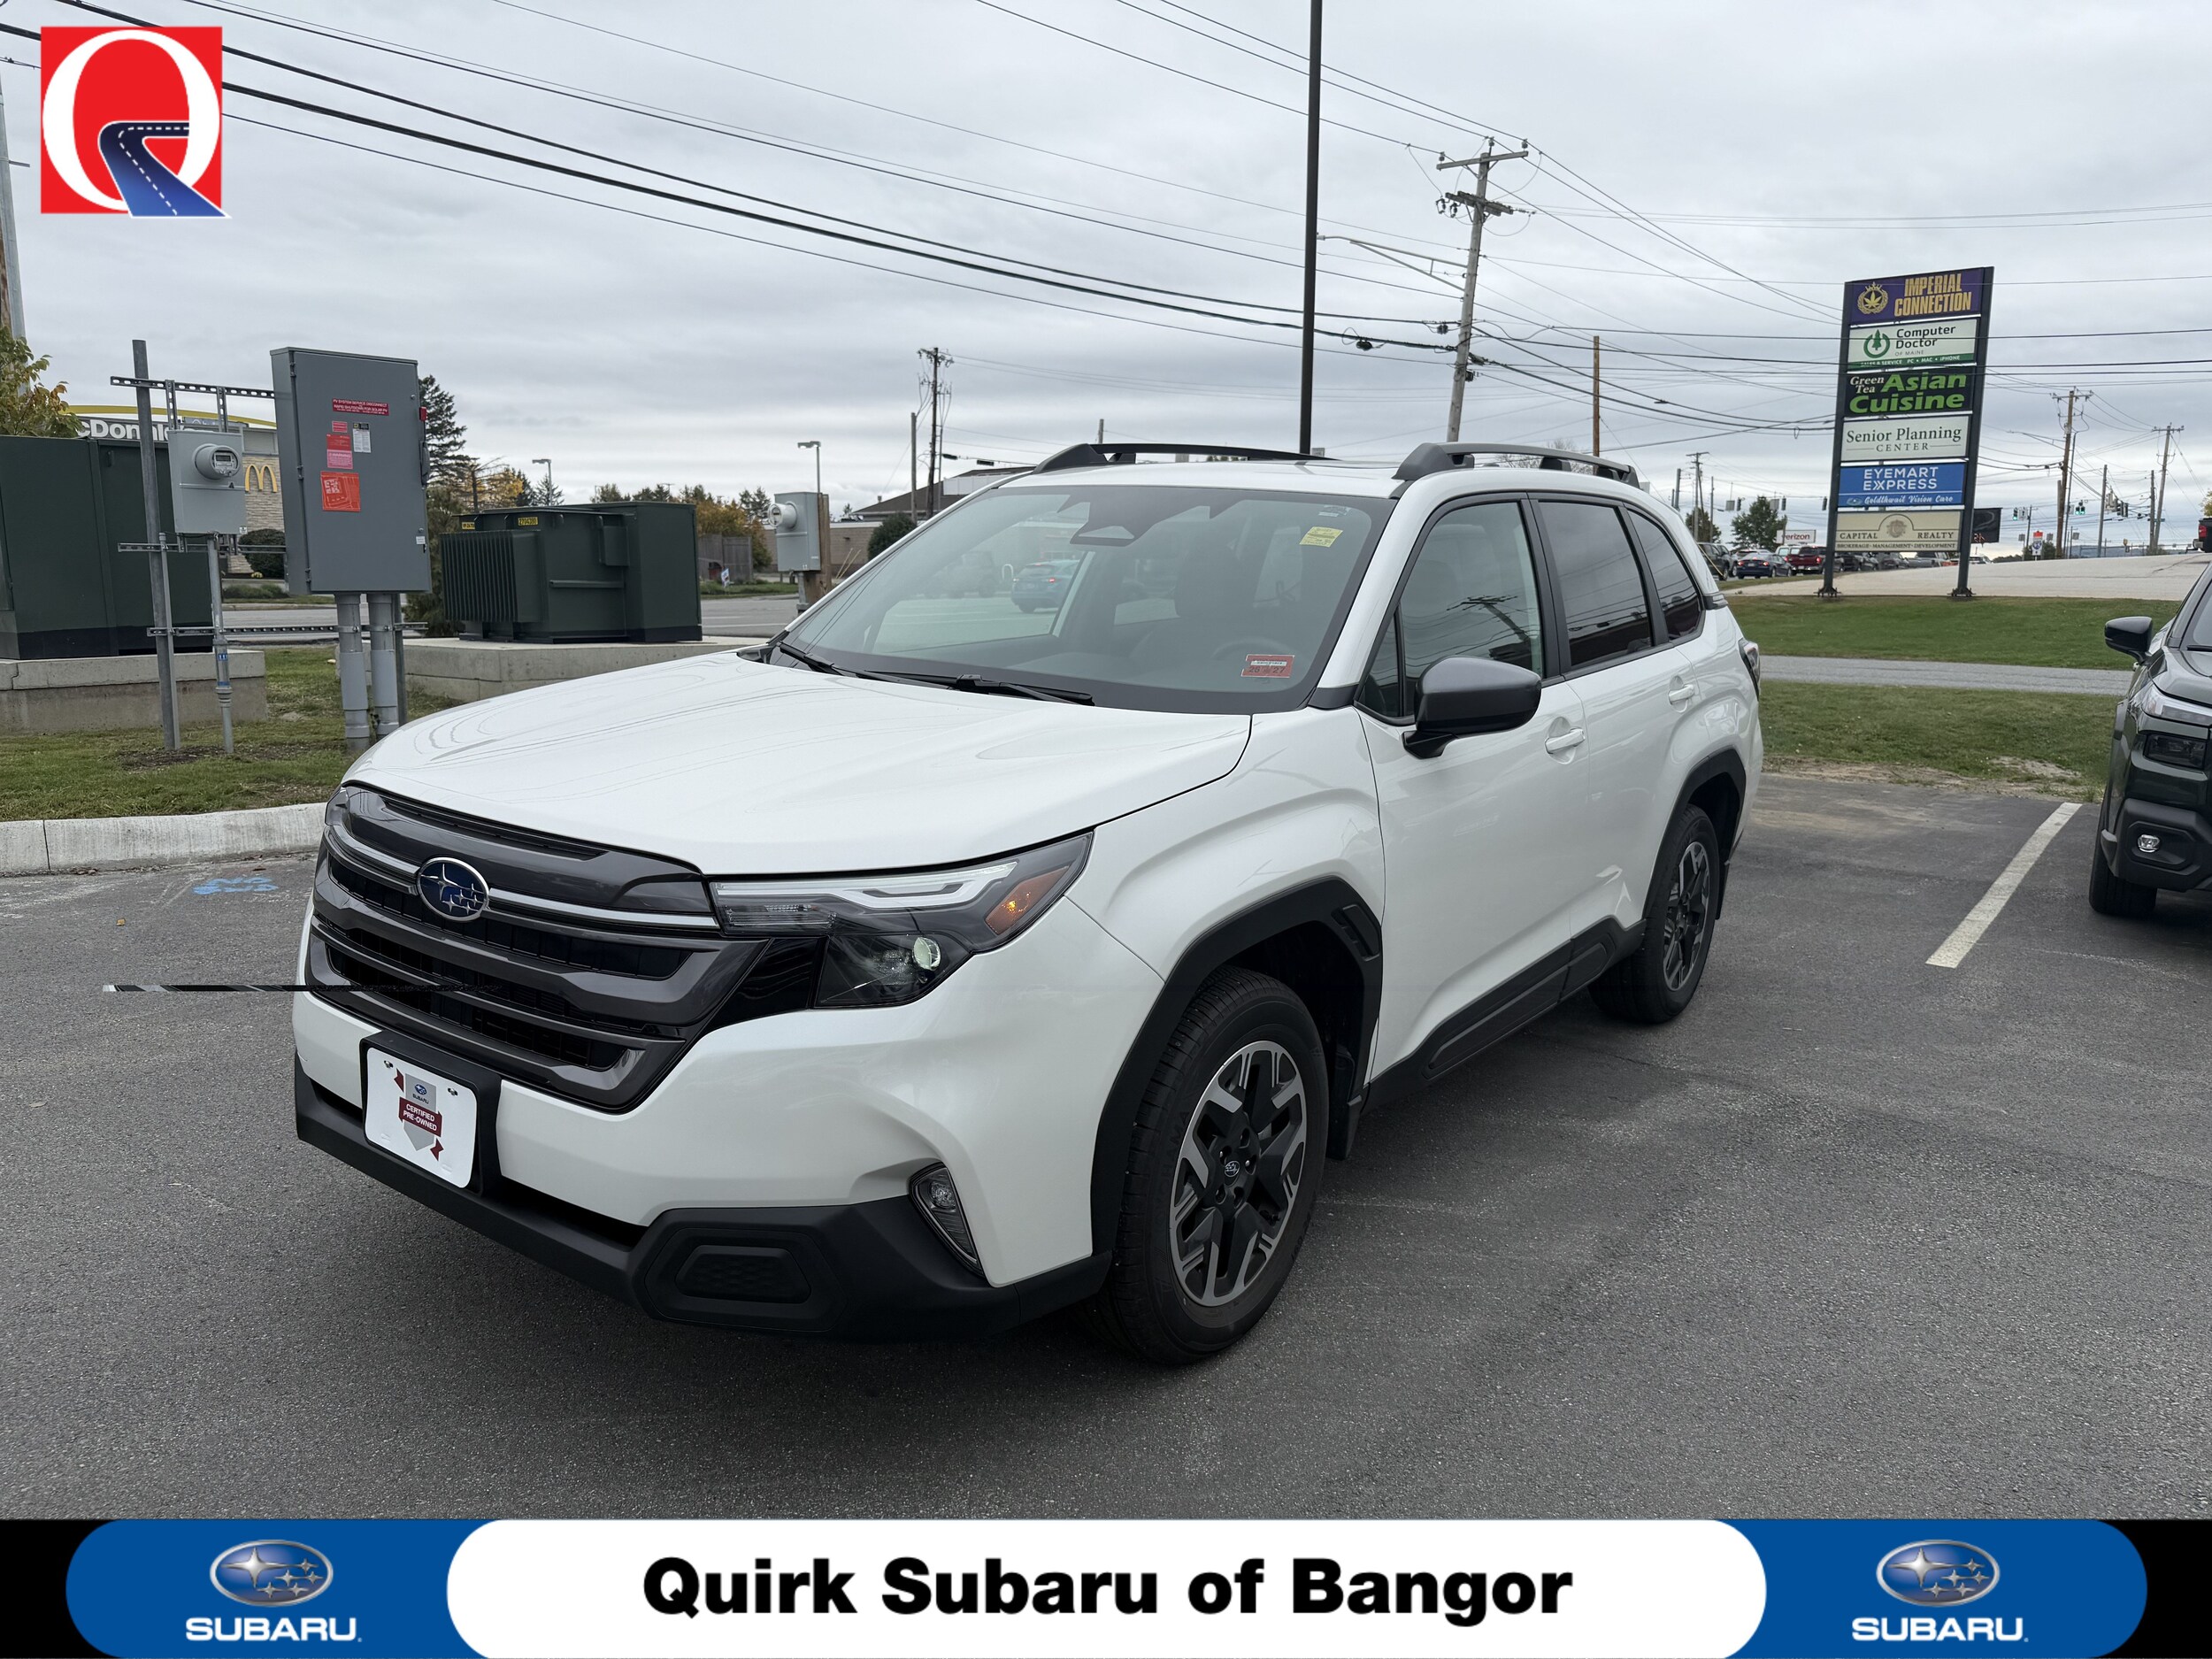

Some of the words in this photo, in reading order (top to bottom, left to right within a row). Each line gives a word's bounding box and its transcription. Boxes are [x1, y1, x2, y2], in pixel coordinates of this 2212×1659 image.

[1904, 273, 1962, 296] IMPERIAL
[1894, 292, 1971, 317] CONNECTION
[1896, 326, 1955, 339] Computer
[1896, 338, 1938, 349] Doctor
[1850, 376, 1885, 386] Green
[1880, 372, 1967, 393] Asian
[1855, 385, 1876, 394] Tea
[1849, 392, 1965, 414] Cuisine
[1846, 429, 1892, 443] Senior
[1895, 426, 1962, 442] Planning
[1876, 442, 1929, 452] CENTER
[1863, 466, 1939, 479] EYEMART
[1908, 495, 1932, 503] Vision
[1935, 495, 1954, 503] Care
[412, 1093, 430, 1104] SUBARU
[406, 1103, 435, 1122] CERTIFIED
[403, 1110, 437, 1132] PRE-OWNED
